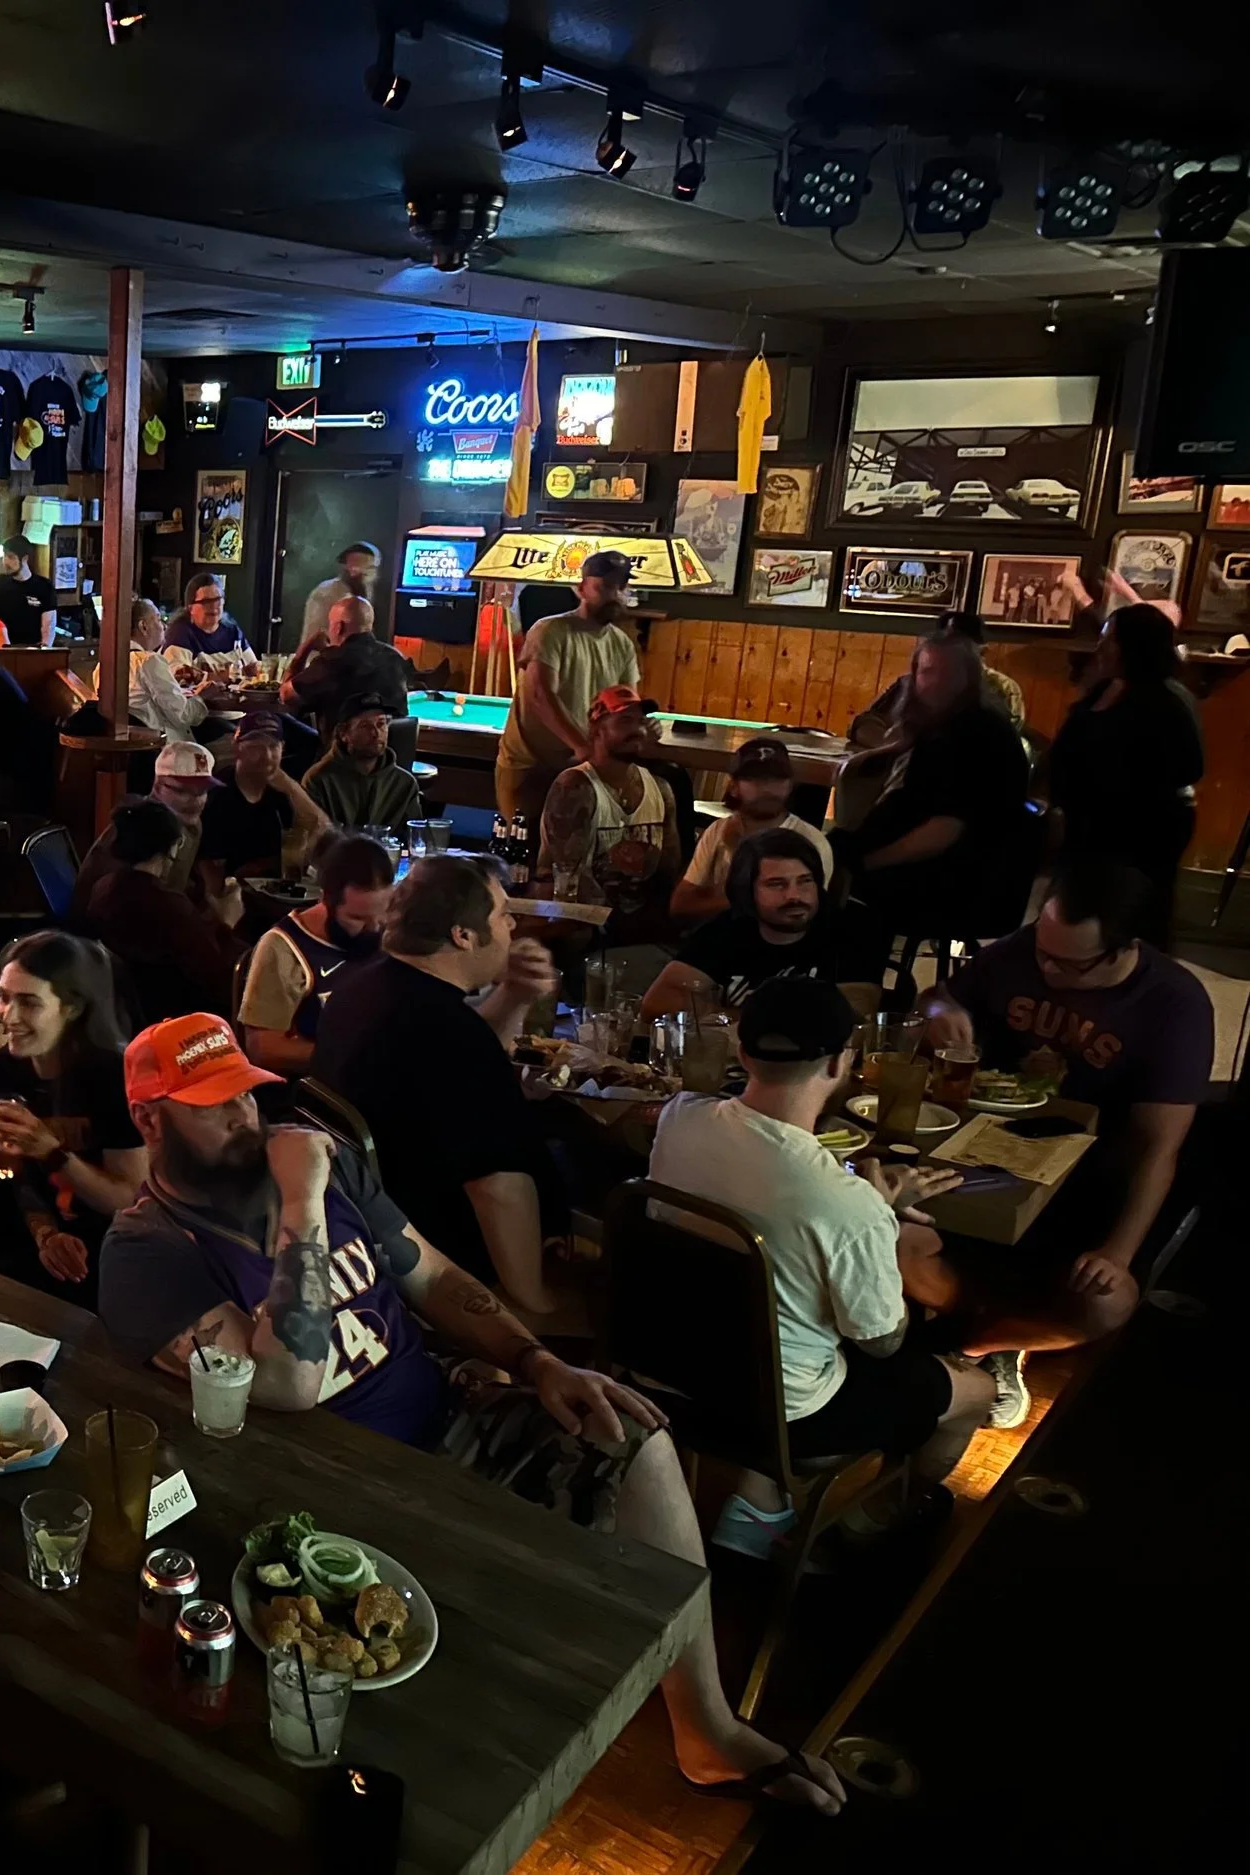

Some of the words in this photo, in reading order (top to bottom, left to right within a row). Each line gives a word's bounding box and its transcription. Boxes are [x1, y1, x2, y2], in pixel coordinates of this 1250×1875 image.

[282, 357, 312, 385] EXIT
[425, 378, 519, 425] Coors
[268, 415, 315, 430] Budweiser
[457, 434, 494, 451] Banquet
[556, 434, 600, 444] Budweiser
[1178, 440, 1238, 453] QSC
[199, 488, 243, 533] Coors
[414, 557, 439, 568] HERE
[440, 557, 457, 569] ON
[510, 547, 550, 569] Lite
[413, 567, 465, 578] TOUCHTUNES
[768, 566, 816, 584] Miller
[1006, 995, 1124, 1069] SUNS
[176, 1041, 208, 1066] PHOENIX
[206, 1032, 229, 1049] SUNS
[148, 1484, 188, 1521] eserved
